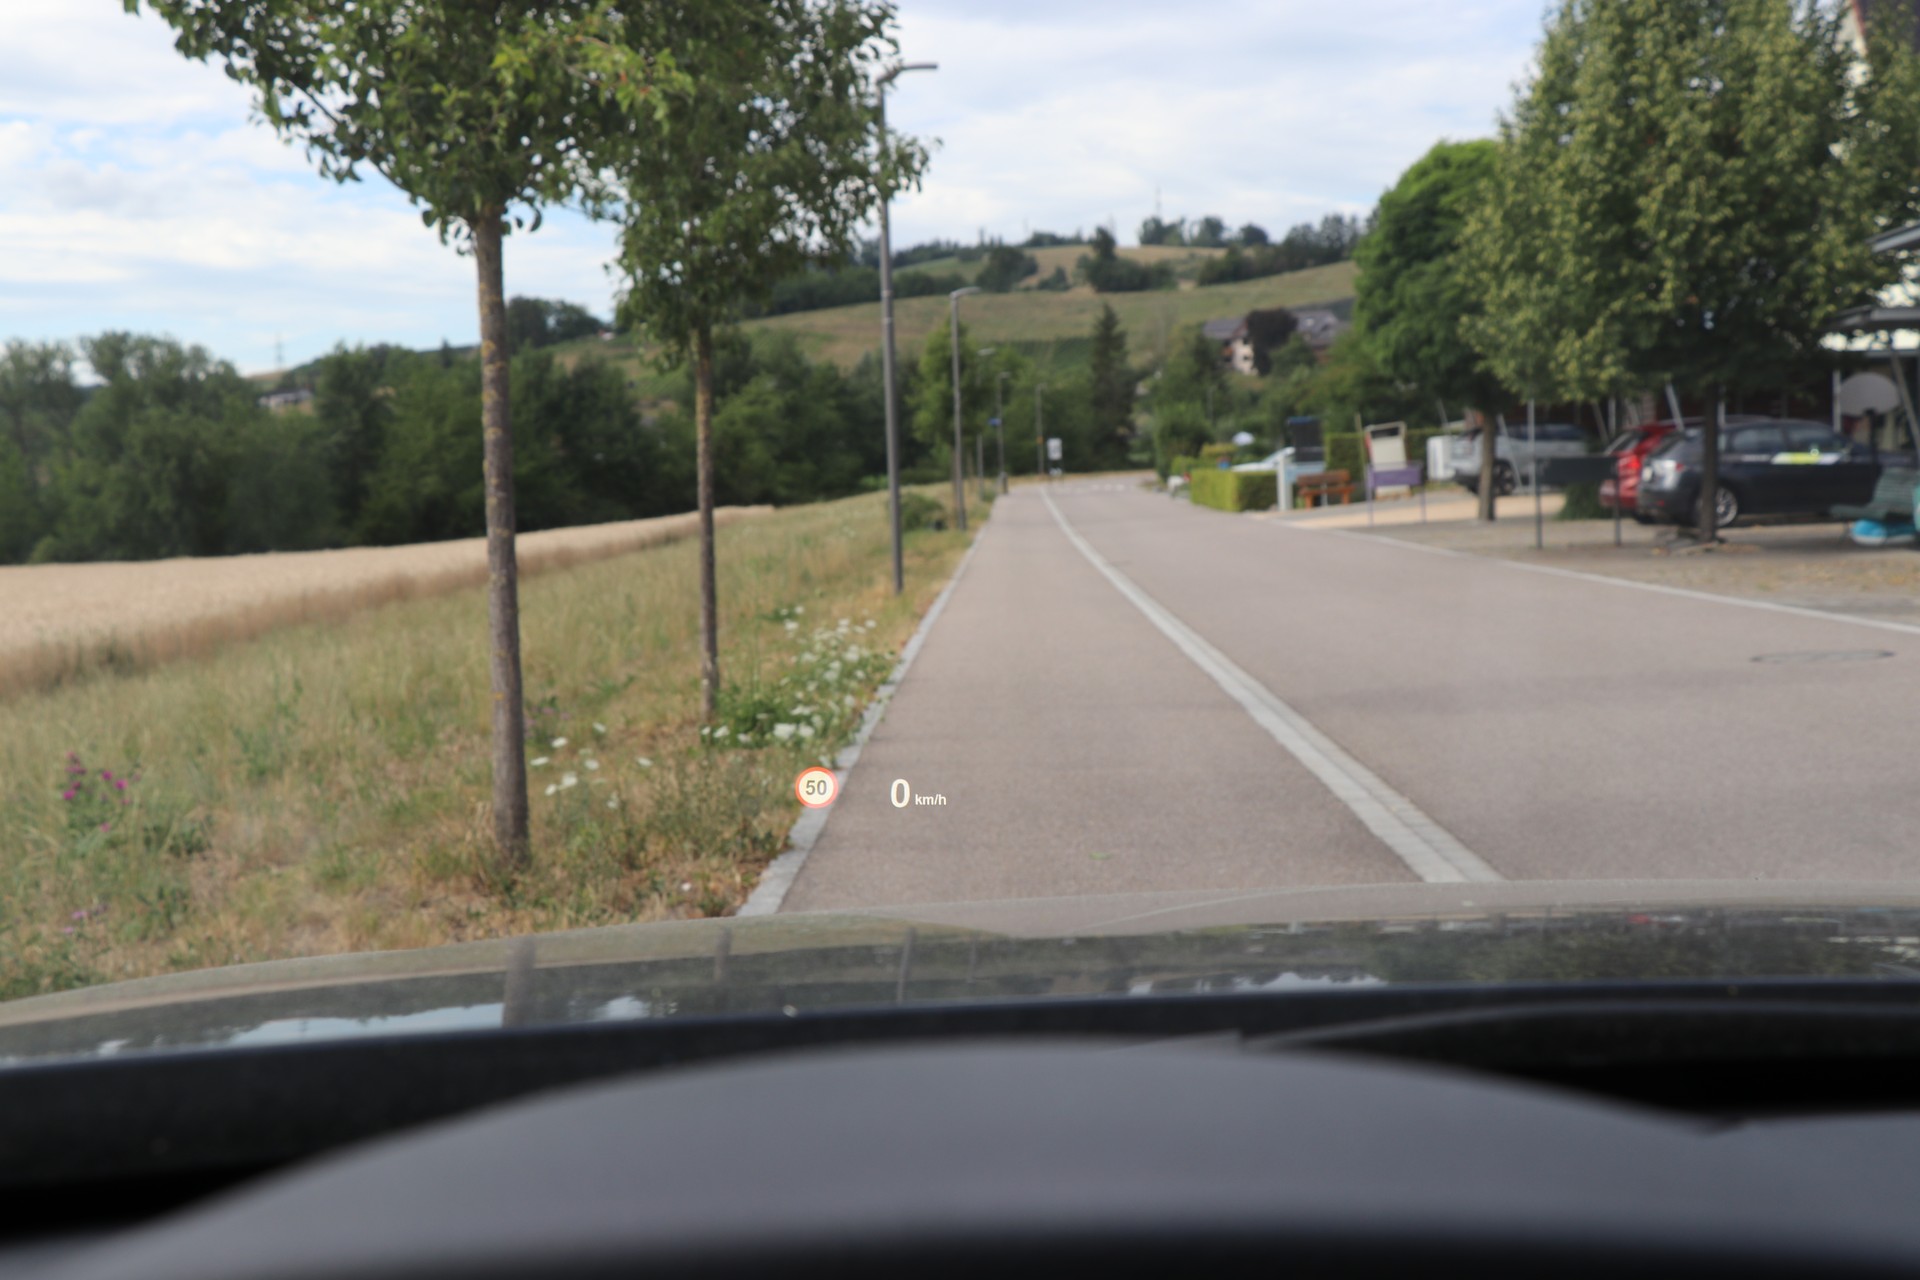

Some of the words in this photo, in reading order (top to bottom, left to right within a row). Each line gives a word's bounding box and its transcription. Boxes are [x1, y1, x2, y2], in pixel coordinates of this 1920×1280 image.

[806, 780, 827, 795] 50
[891, 779, 910, 808] 0
[915, 794, 947, 805] km/h
